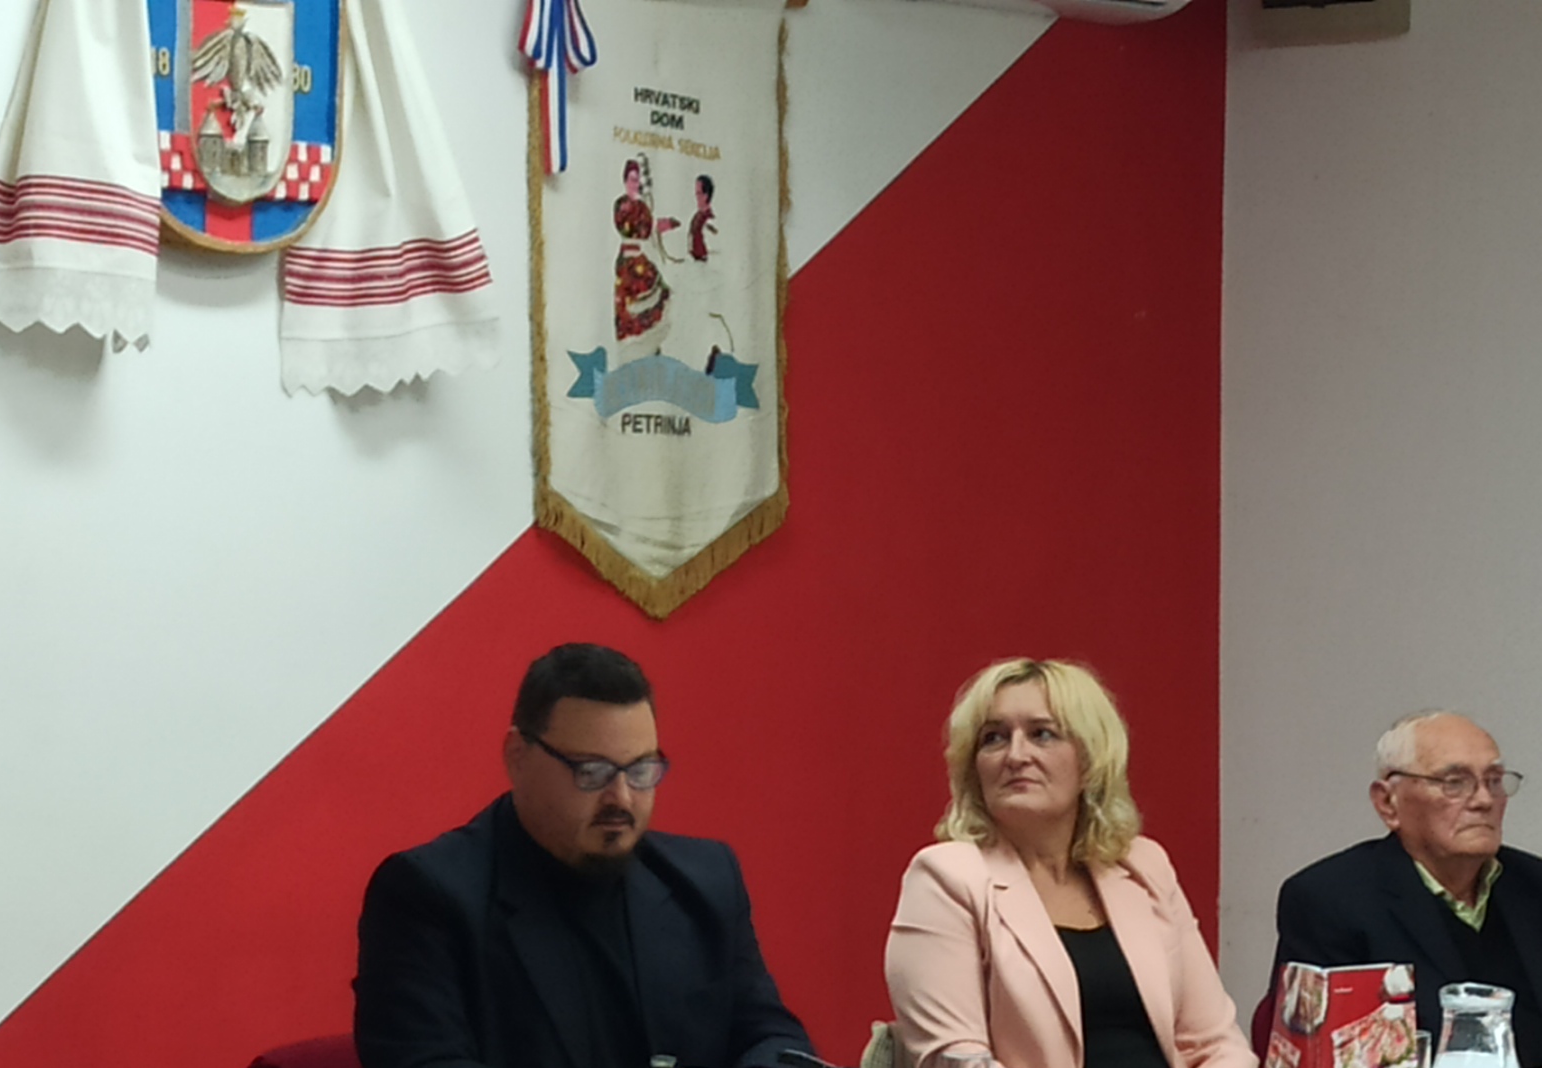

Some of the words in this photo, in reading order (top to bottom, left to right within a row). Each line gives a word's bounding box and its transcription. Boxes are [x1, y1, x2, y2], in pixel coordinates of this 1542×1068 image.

[633, 86, 701, 115] HRVATSKI
[650, 110, 685, 131] DOM
[620, 412, 692, 436] PETRINJA
